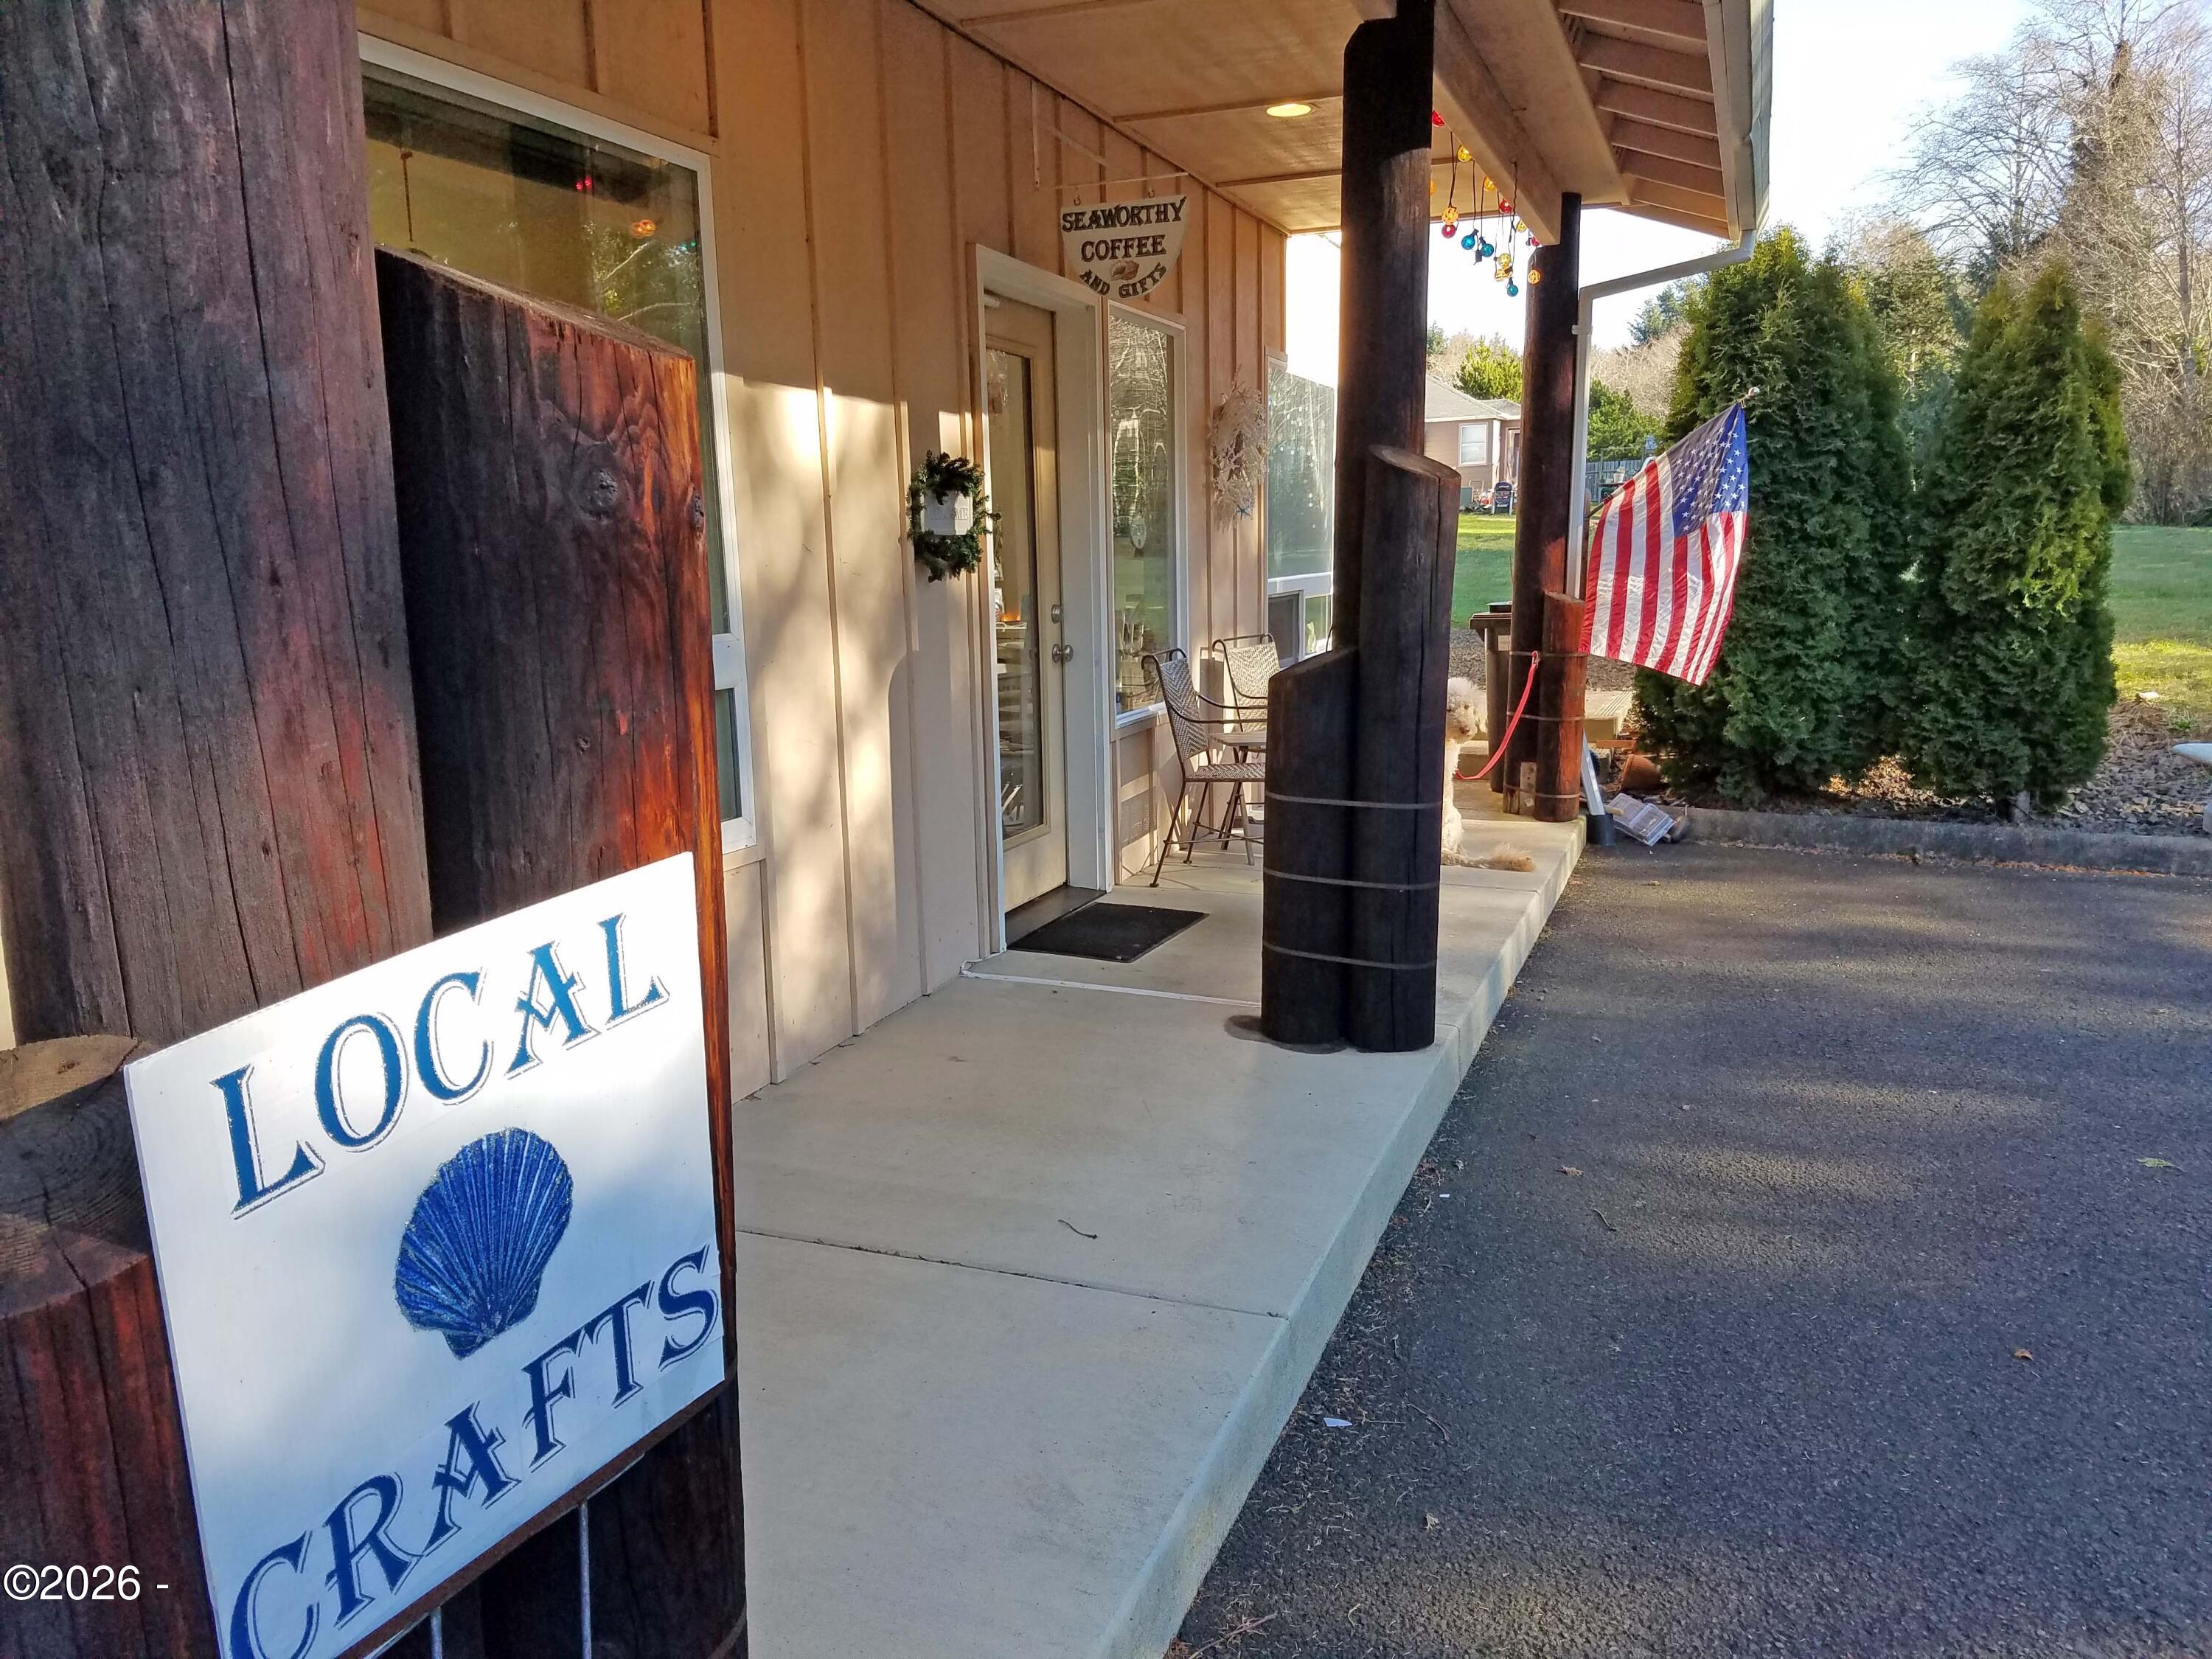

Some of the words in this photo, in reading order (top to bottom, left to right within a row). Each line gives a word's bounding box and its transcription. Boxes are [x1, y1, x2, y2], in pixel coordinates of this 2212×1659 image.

[1062, 196, 1187, 232] SEAWORTHY
[1081, 234, 1166, 262] COFFEE
[1079, 269, 1110, 296] AND
[1119, 262, 1167, 299] GIFTS
[209, 913, 669, 1220] LOCAL
[228, 1245, 722, 1658] CRAFTS
